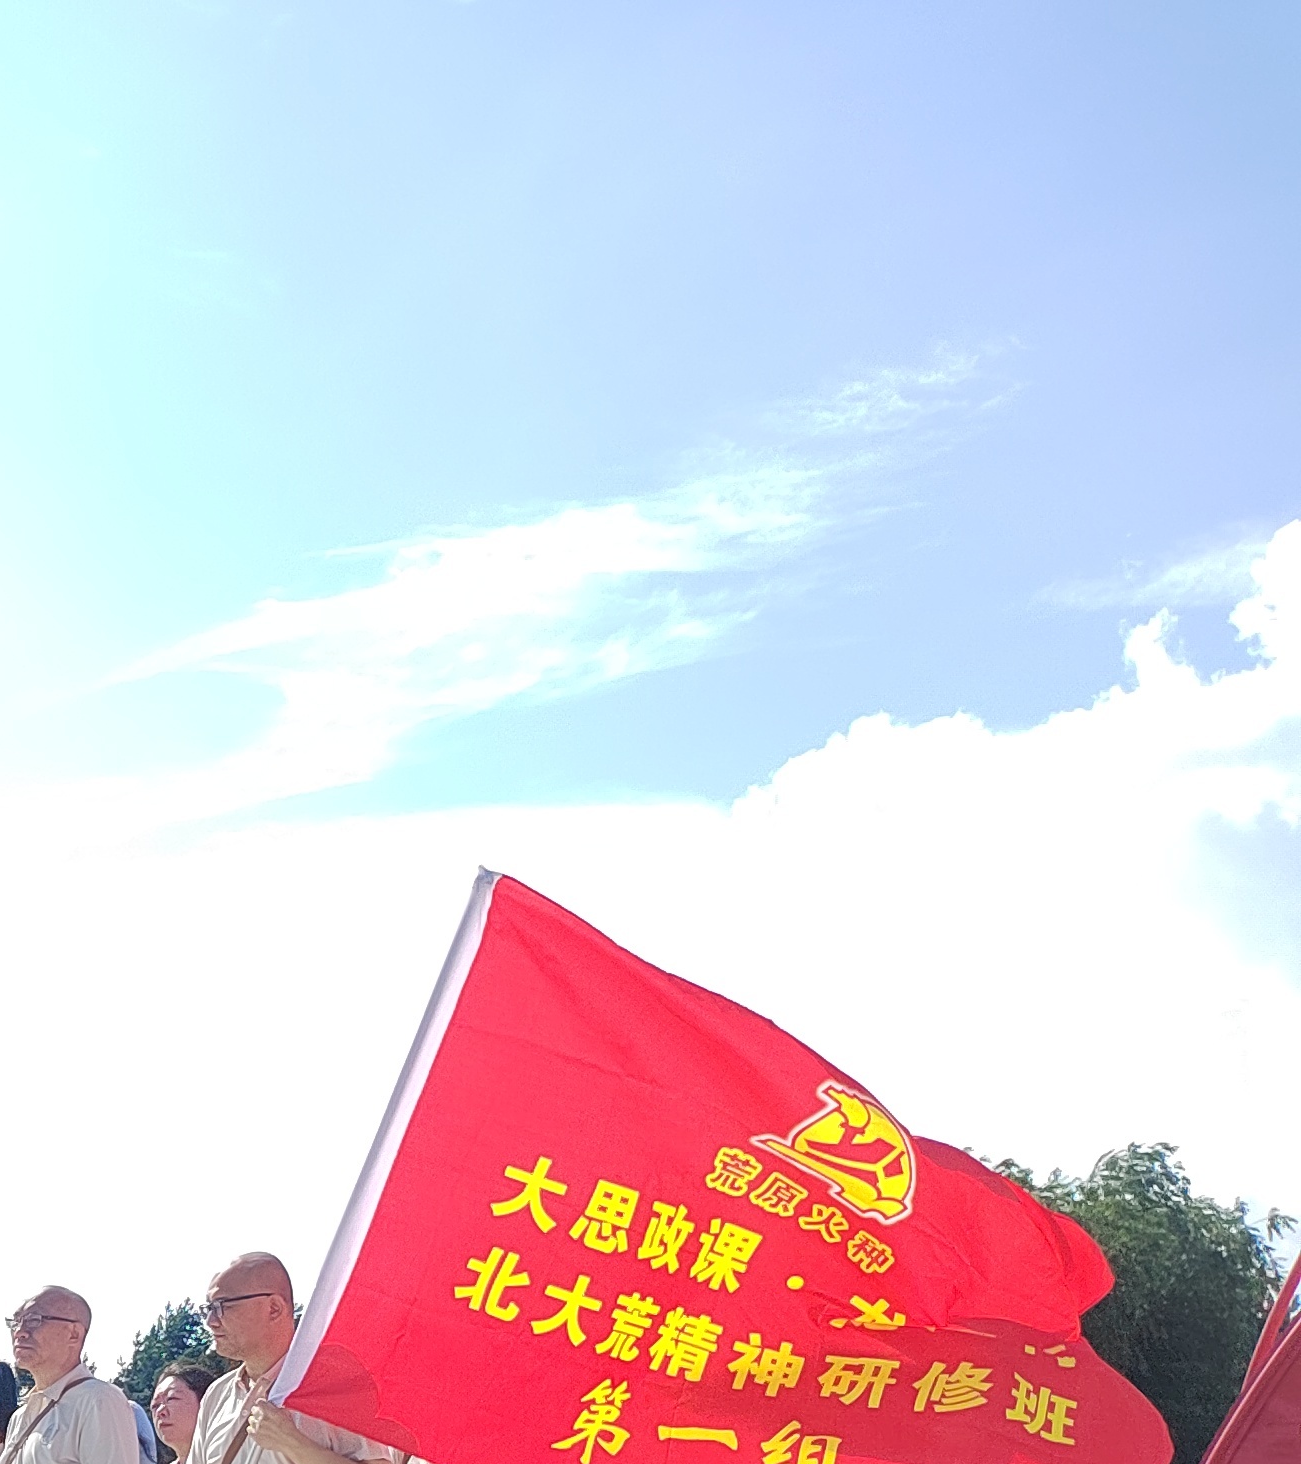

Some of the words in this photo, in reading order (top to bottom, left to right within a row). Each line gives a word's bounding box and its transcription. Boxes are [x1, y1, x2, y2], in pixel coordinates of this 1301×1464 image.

[706, 1147, 895, 1275] 荒原火种
[454, 1246, 1078, 1446] 北大荒精神研修班
